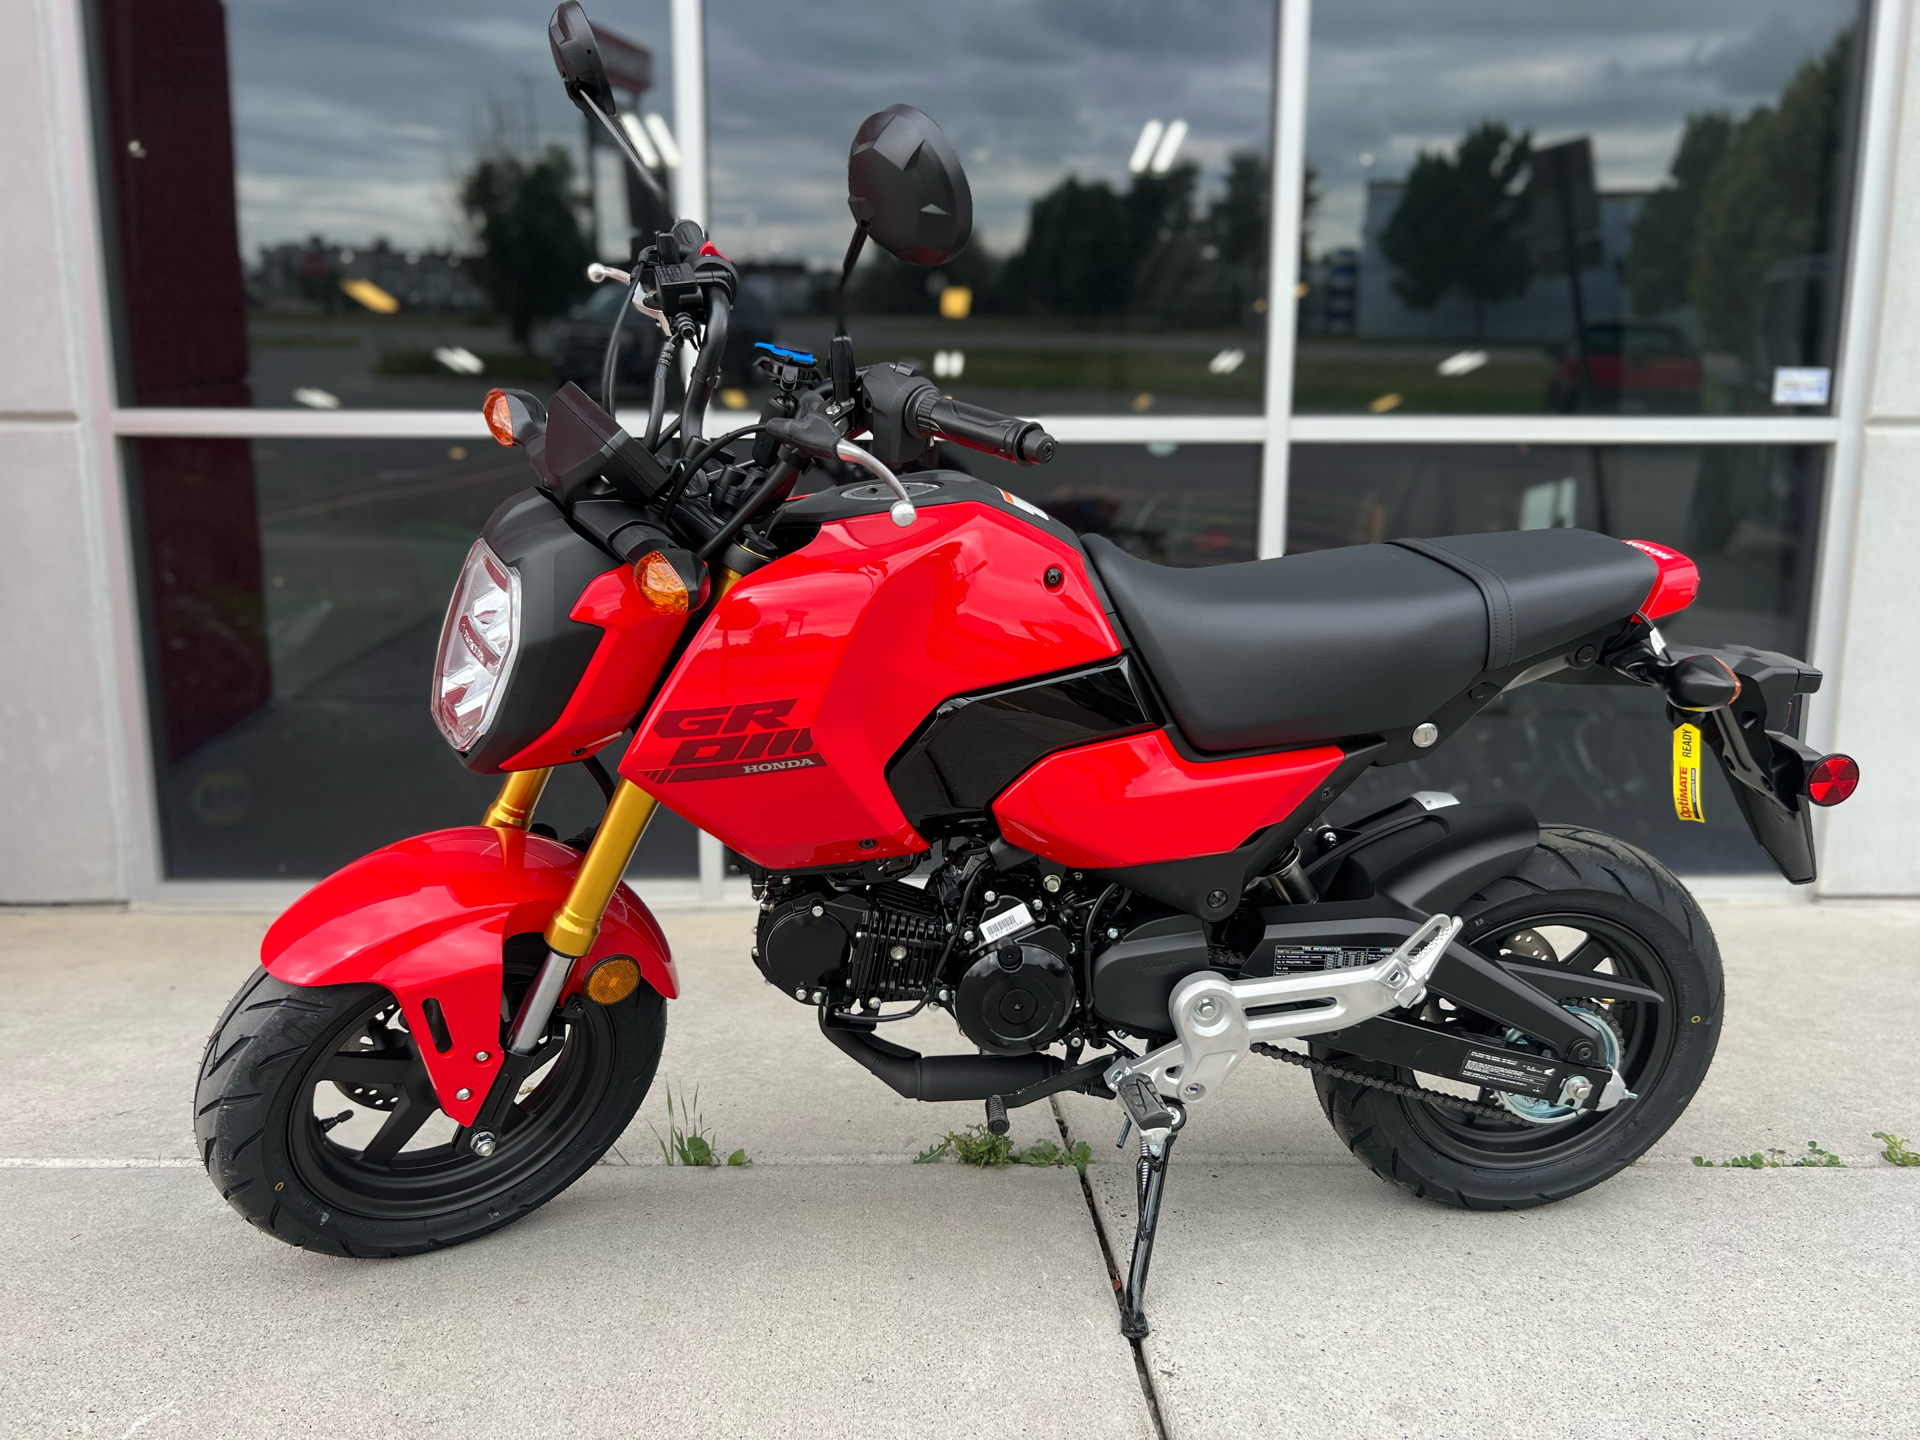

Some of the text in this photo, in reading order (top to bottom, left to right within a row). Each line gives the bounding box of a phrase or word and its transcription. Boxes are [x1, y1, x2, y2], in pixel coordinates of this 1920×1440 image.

[743, 758, 816, 774] HONDA
[1677, 728, 1692, 819] OptiMATE READY
